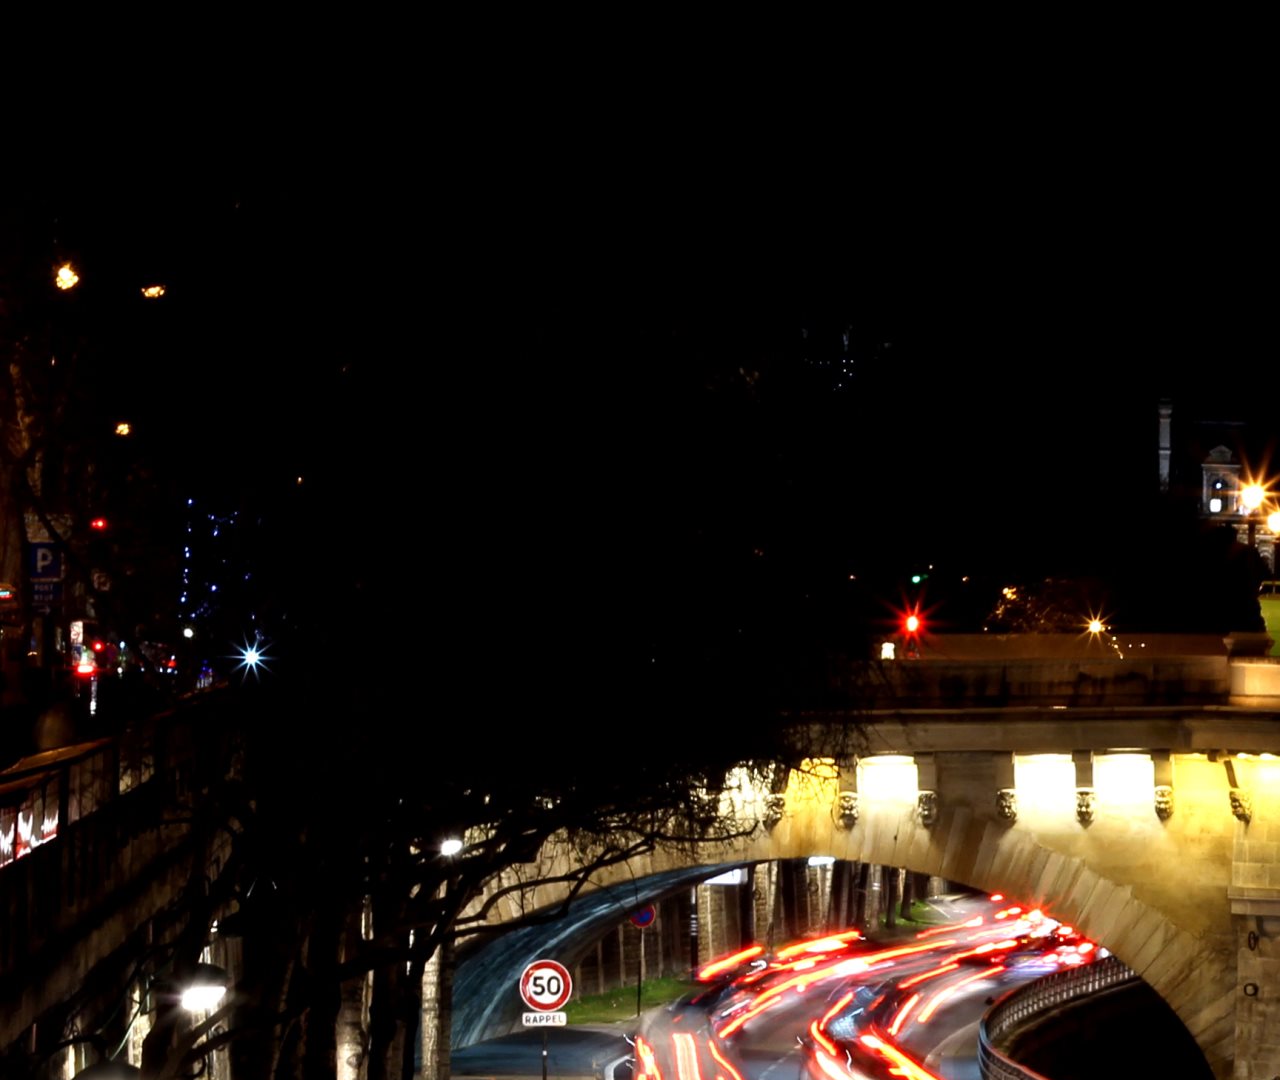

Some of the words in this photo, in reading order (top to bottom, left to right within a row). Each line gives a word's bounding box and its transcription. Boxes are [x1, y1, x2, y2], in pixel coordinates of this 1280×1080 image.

[36, 547, 54, 574] P
[533, 976, 561, 996] 50
[525, 1014, 564, 1024] RAPPEL
